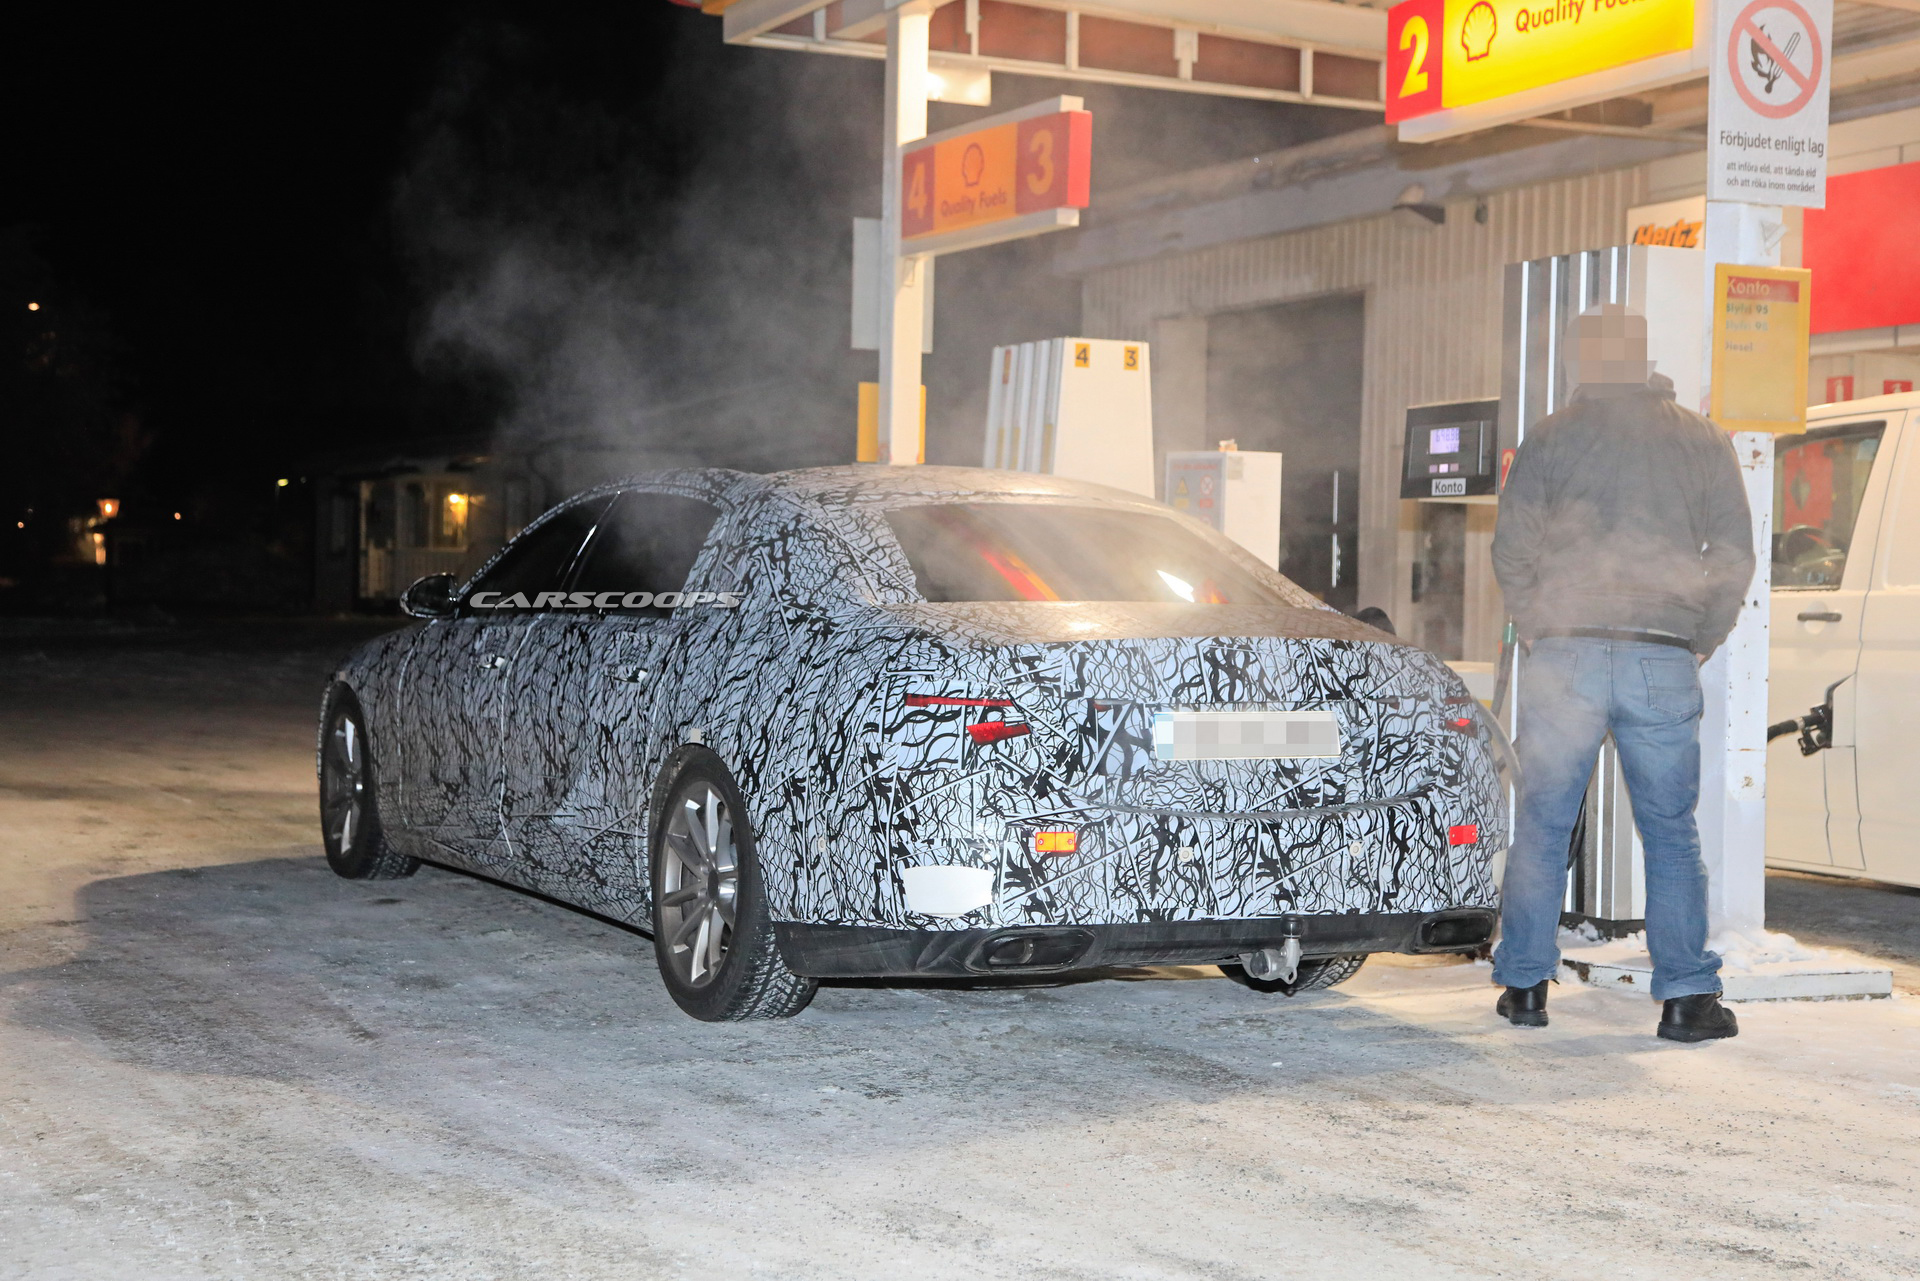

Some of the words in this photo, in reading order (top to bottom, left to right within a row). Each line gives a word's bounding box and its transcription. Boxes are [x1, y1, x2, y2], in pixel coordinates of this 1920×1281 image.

[1516, 0, 1584, 32] Quality
[1398, 15, 1429, 99] 2
[1719, 130, 1771, 151] Förbjudet
[1774, 136, 1805, 156] enligt
[1808, 137, 1824, 158] lag
[1026, 129, 1055, 196] 3
[1726, 161, 1736, 171] att
[1738, 162, 1758, 173] införa
[1773, 165, 1783, 175] att
[1785, 166, 1804, 177] tända
[1806, 167, 1817, 178] eld
[908, 161, 927, 220] 4
[1726, 176, 1739, 187] och
[1741, 178, 1750, 188] att
[1752, 178, 1767, 189] röka
[1768, 180, 1785, 190] inom
[1787, 181, 1815, 192] området
[940, 194, 976, 218] Quality
[979, 188, 1008, 210] Fuels
[1633, 218, 1703, 249] Hertz
[1727, 277, 1770, 297] Konto
[1755, 303, 1769, 315] 95
[1076, 347, 1088, 365] 4
[1126, 350, 1137, 367] 3
[1434, 481, 1463, 494] Konto
